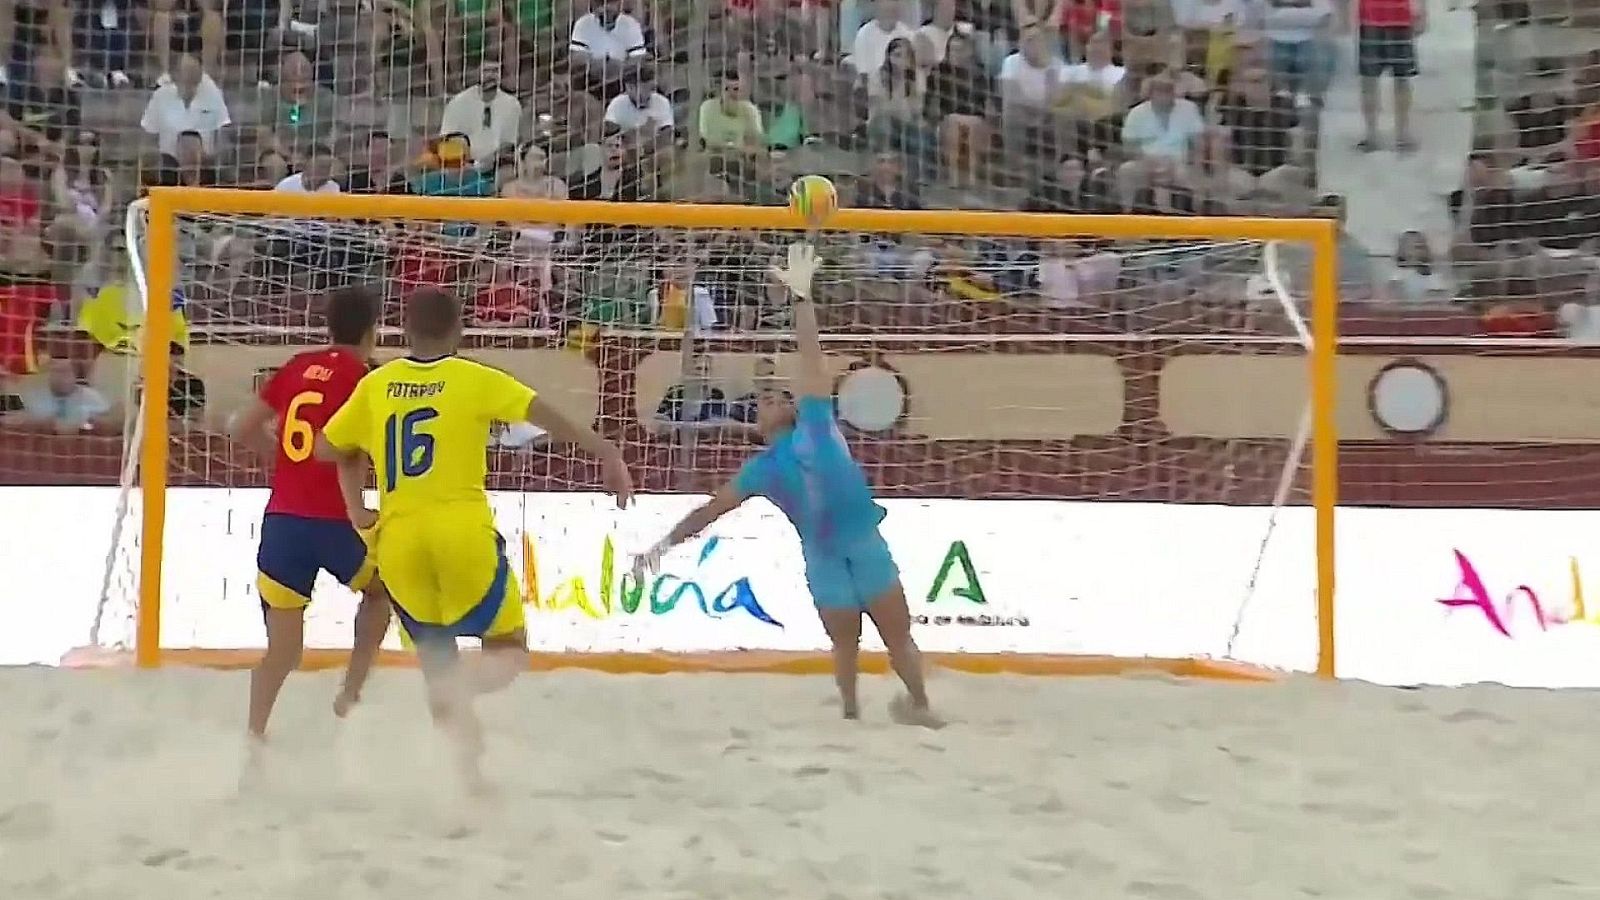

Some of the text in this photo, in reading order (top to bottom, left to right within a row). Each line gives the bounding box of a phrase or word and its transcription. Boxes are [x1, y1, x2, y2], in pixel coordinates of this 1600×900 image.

[386, 380, 446, 400] POTAPOV
[281, 391, 324, 462] 6
[384, 407, 438, 493] 16
[926, 540, 988, 604] A
[1435, 547, 1600, 638] And
